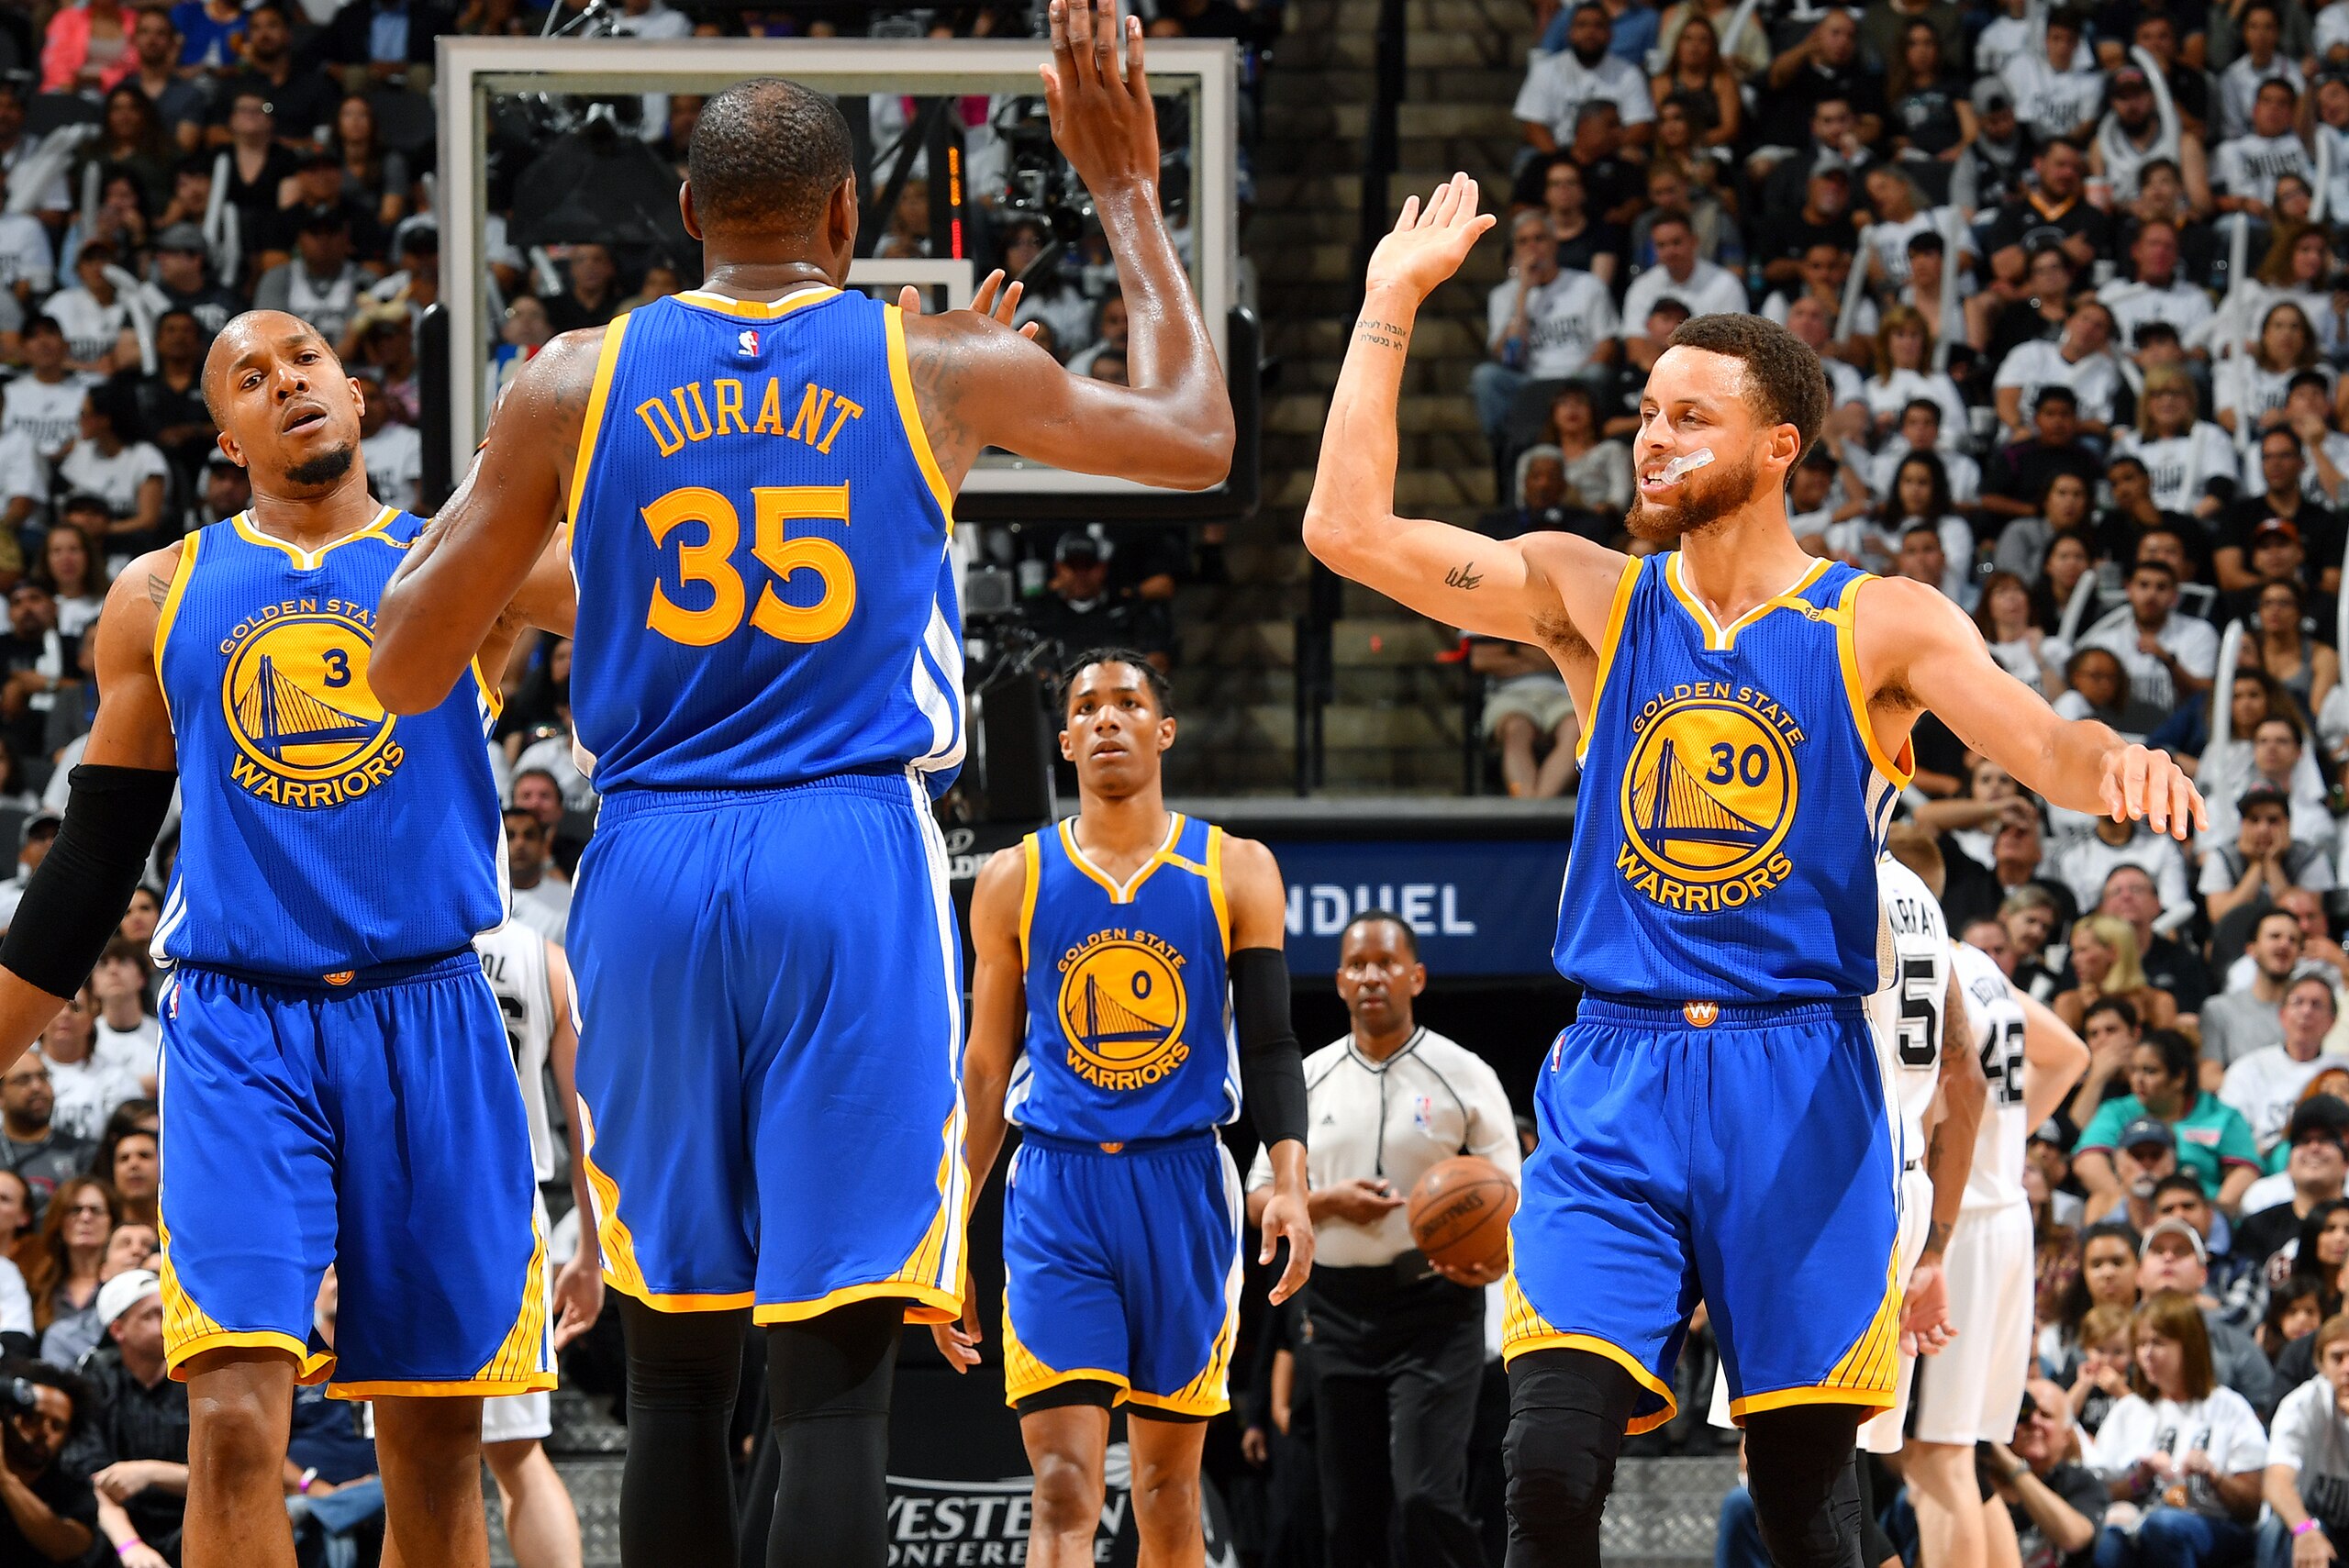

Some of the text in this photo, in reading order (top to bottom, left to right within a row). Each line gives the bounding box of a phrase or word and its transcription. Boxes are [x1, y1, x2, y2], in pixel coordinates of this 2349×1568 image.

[635, 377, 864, 458] DURANT
[640, 479, 857, 647] 35
[220, 598, 377, 655] GOLDEN STA
[322, 648, 351, 688] 3
[1632, 682, 1806, 747] GOLDEN STATE
[230, 740, 405, 807] WARRIORS
[1706, 741, 1770, 787] 30
[1616, 841, 1794, 912] WARRIORS
[1286, 884, 1476, 936] NDUEL
[1057, 928, 1187, 973] GOLDEN STATE
[1131, 970, 1152, 1000] 0
[1898, 955, 1938, 1070] 5
[1066, 1040, 1191, 1091] WARRIORS
[1980, 1019, 2024, 1105] 42
[887, 1494, 1127, 1541] ESTEN
